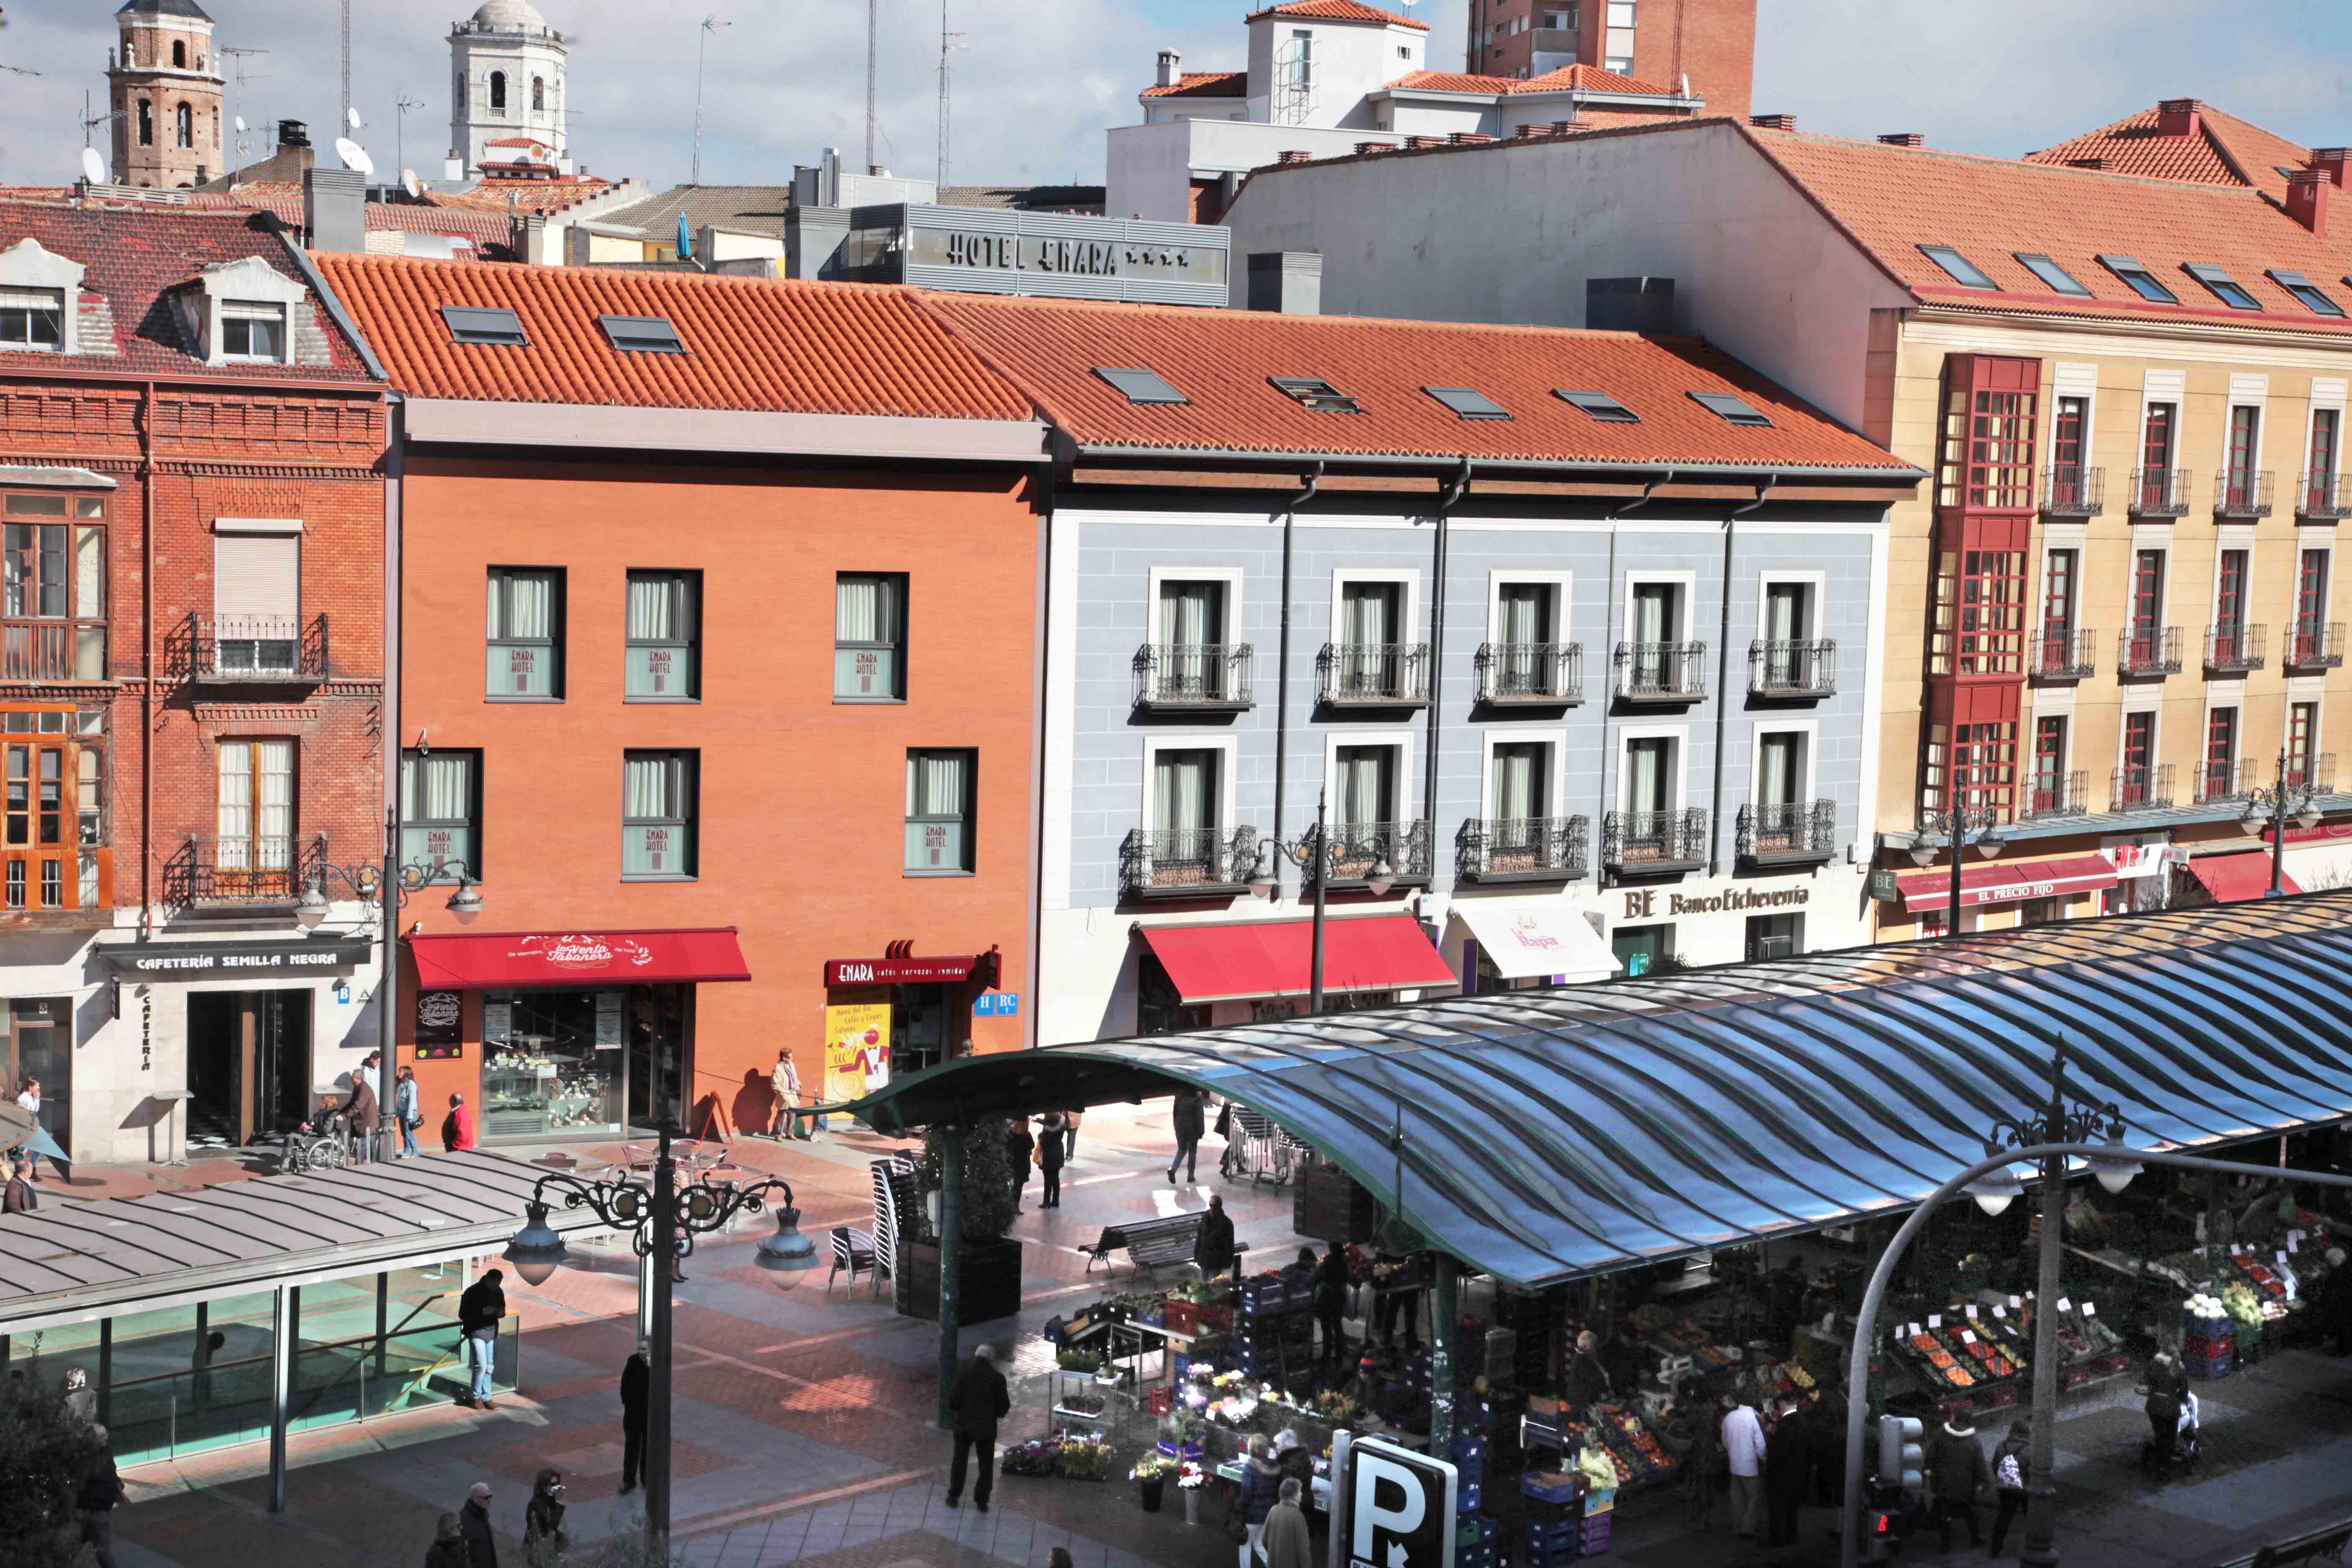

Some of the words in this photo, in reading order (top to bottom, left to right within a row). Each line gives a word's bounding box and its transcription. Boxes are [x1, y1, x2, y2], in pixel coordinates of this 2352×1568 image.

[946, 233, 1027, 269] HOTEL
[511, 650, 534, 661] ENARA
[650, 651, 671, 662] ENARA
[856, 653, 877, 663] ENARA
[511, 662, 534, 673] HOTEL
[650, 663, 671, 673] HOTEL
[856, 664, 877, 675] HOTEL
[647, 830, 668, 841] ENARA
[926, 826, 946, 836] ENARA
[428, 832, 451, 842] ENARA
[926, 837, 946, 847] HOTEL
[428, 843, 451, 854] HOTEL
[647, 841, 668, 851] HOTEL
[1978, 891, 1990, 902] EL
[1994, 887, 2030, 900] PRECIO
[2033, 884, 2054, 896] FIJO
[1669, 893, 1722, 915] Banco
[1723, 885, 1809, 911] Etcheverría
[565, 944, 609, 954] Venta
[547, 951, 613, 961] Tabanera
[137, 954, 214, 970] CAFETERÍA
[222, 955, 281, 966] SEMILLA
[290, 954, 337, 965] NEGRA
[838, 964, 874, 982] ENARA
[980, 996, 990, 1008] H
[999, 994, 1016, 1007] RC
[1353, 1451, 1426, 1561] P
